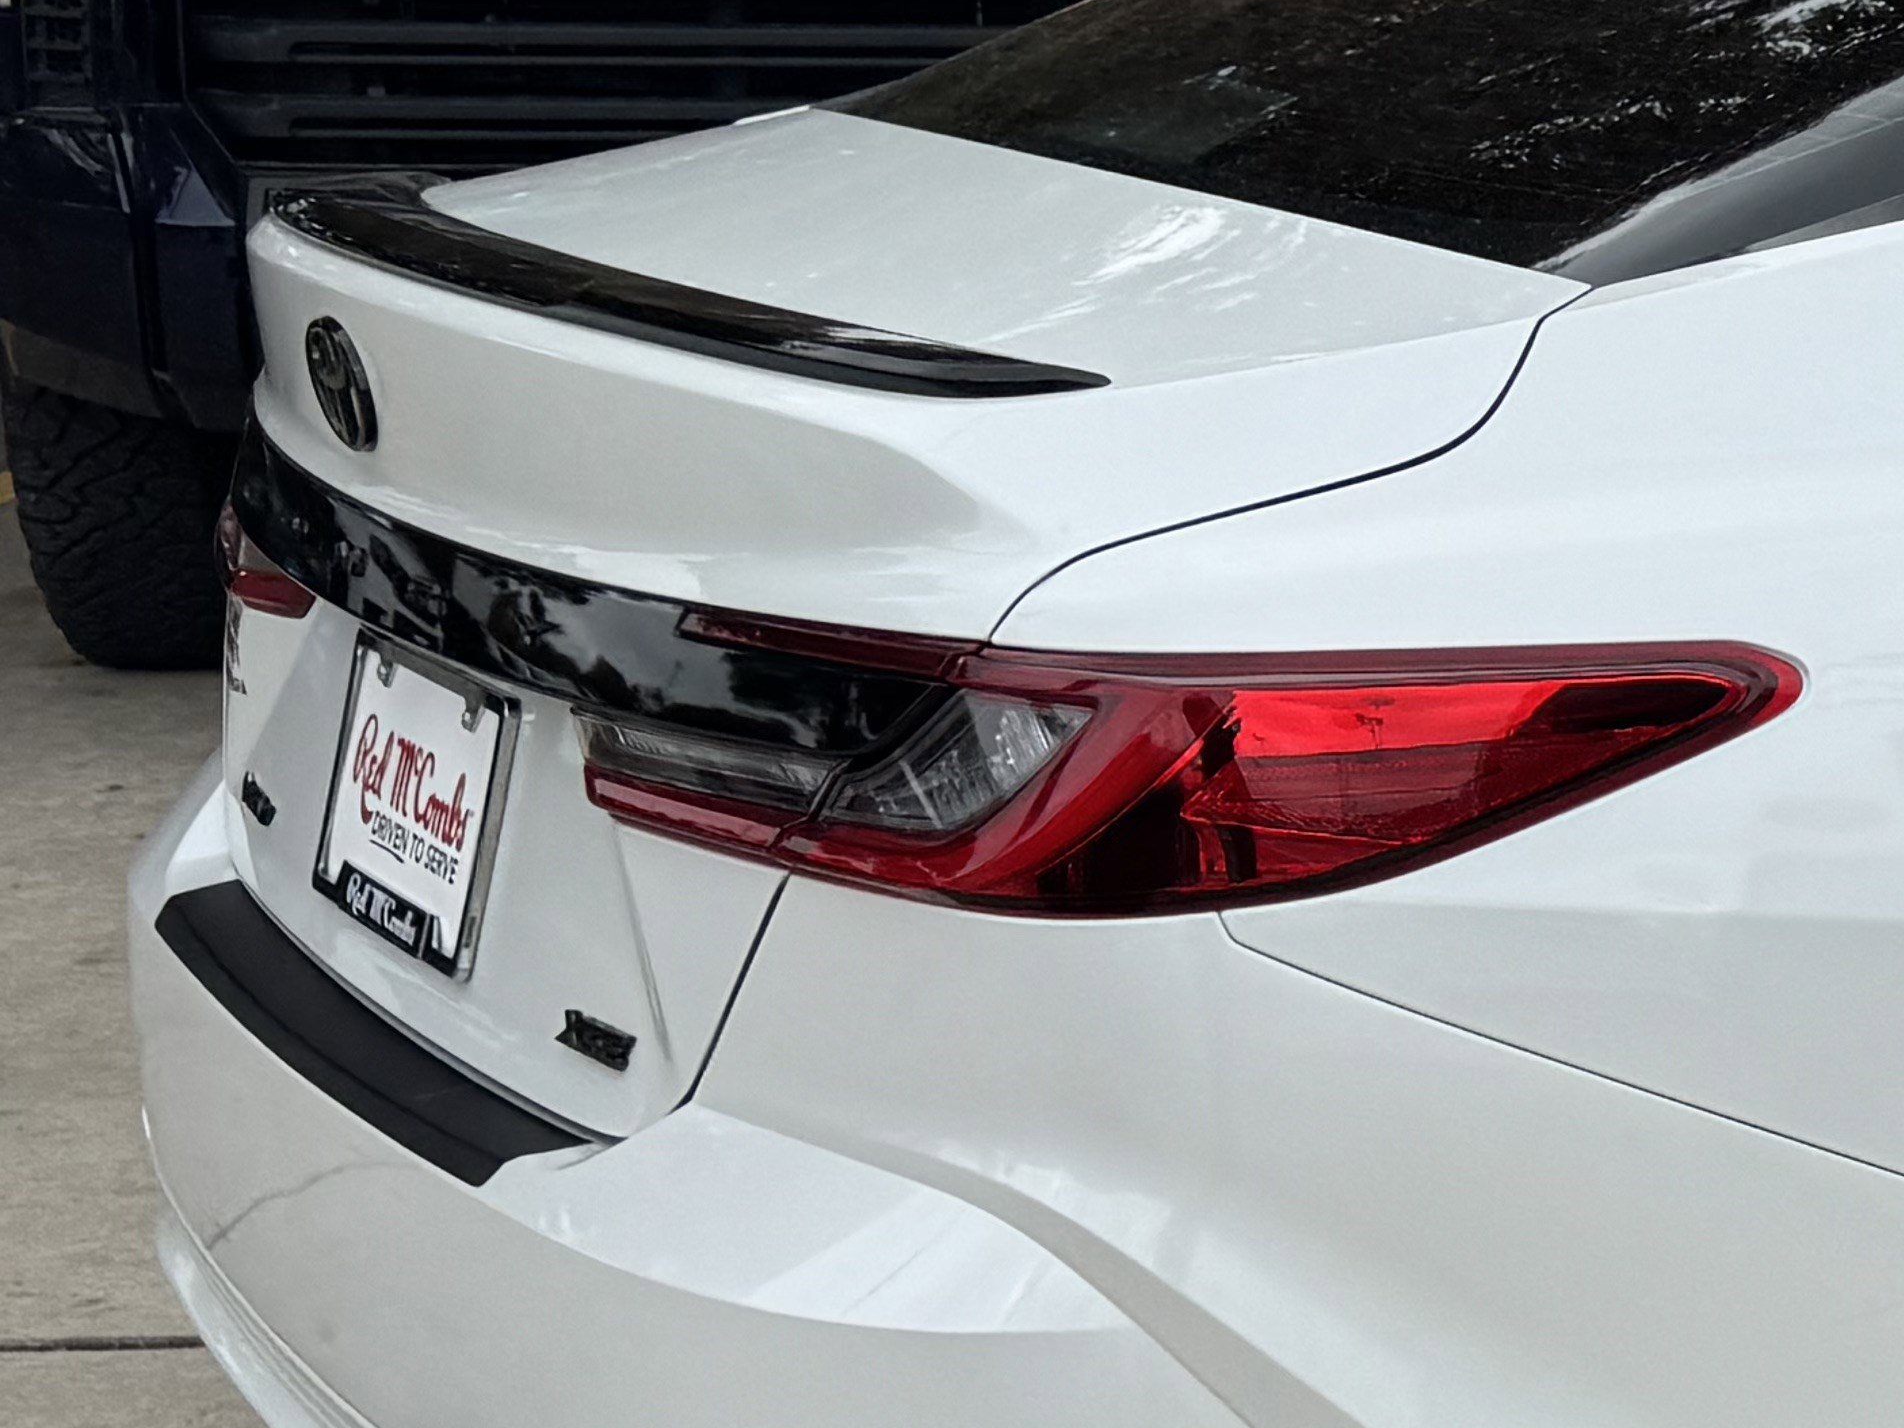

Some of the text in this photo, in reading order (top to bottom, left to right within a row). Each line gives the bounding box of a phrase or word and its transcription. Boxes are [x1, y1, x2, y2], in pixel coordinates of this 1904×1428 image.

[353, 713, 394, 824] Red
[389, 736, 470, 852] McCombs
[371, 810, 459, 884] DRIVEN TO SERVE
[346, 873, 371, 916] Red
